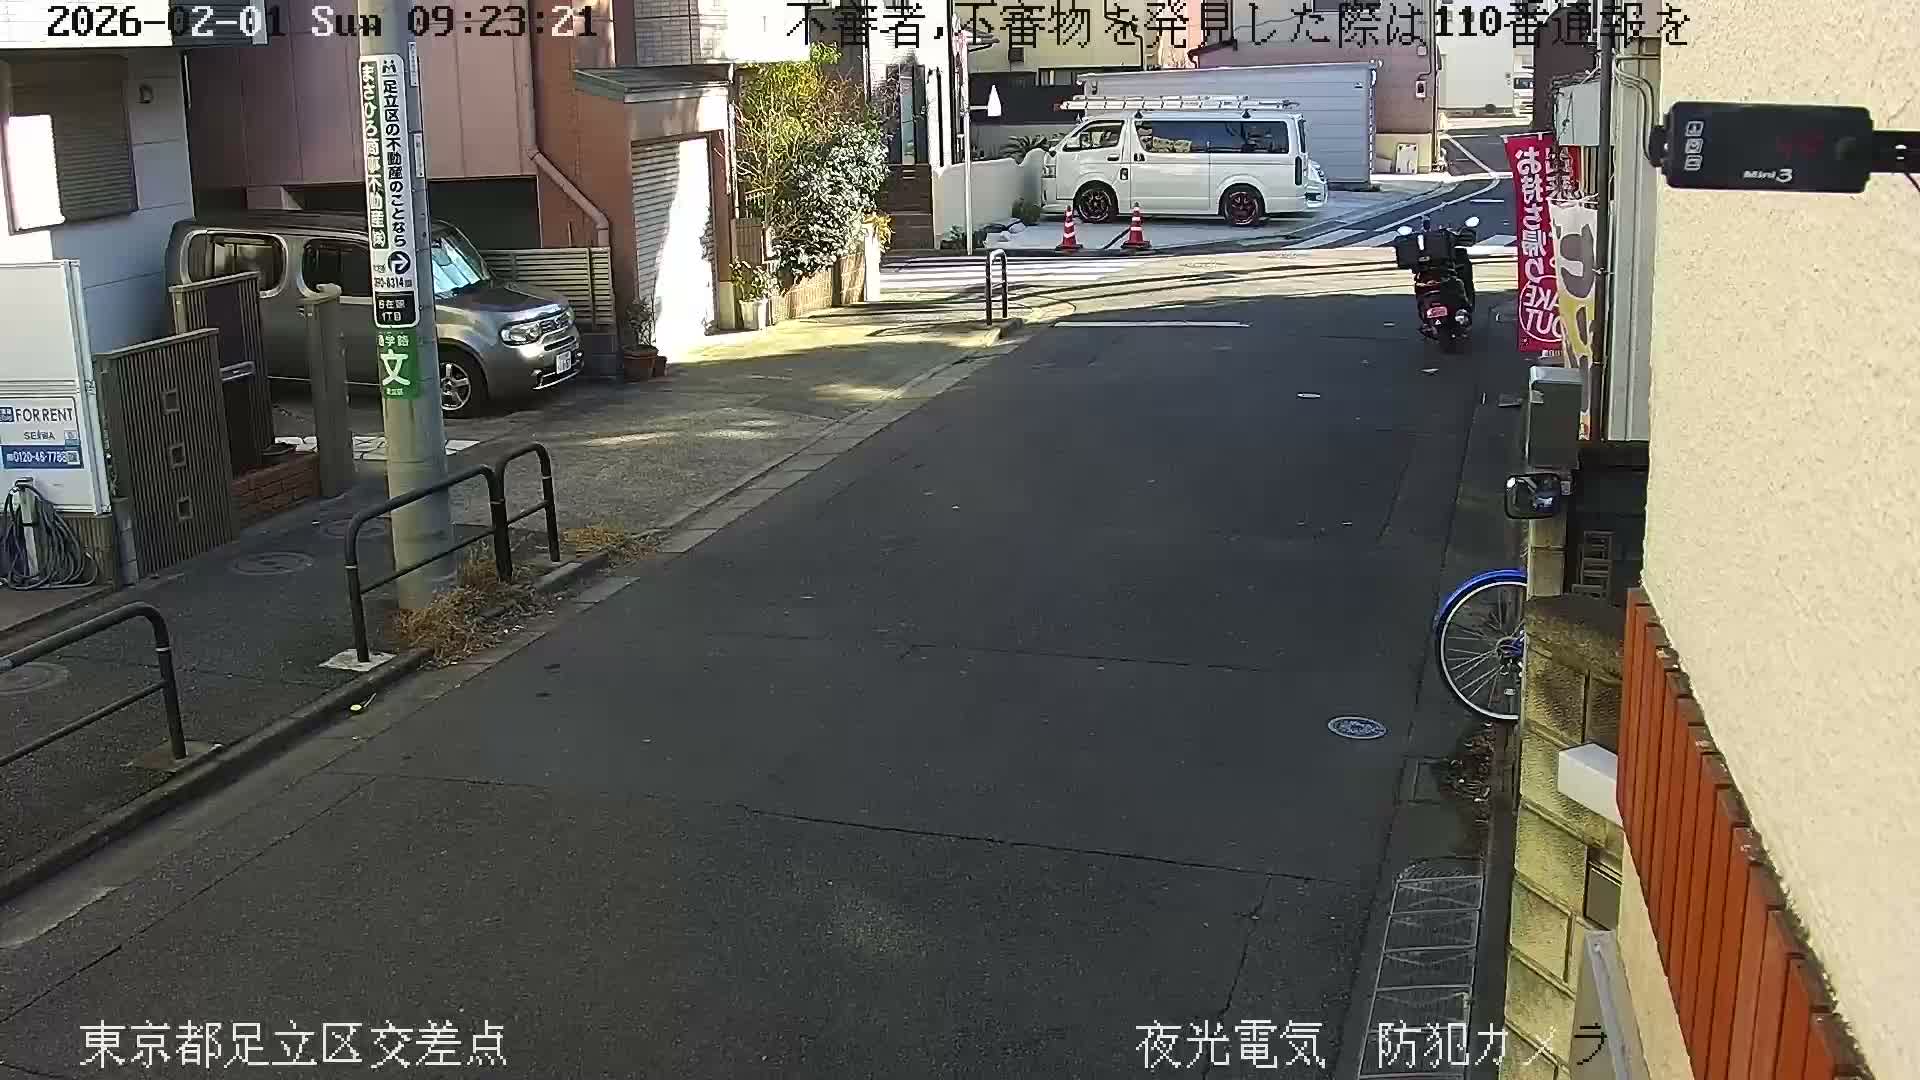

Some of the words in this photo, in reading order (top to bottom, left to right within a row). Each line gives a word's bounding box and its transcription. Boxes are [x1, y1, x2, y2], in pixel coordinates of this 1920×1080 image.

[380, 348, 411, 386] 文
[15, 408, 40, 422] FOR
[42, 408, 73, 422] RENT
